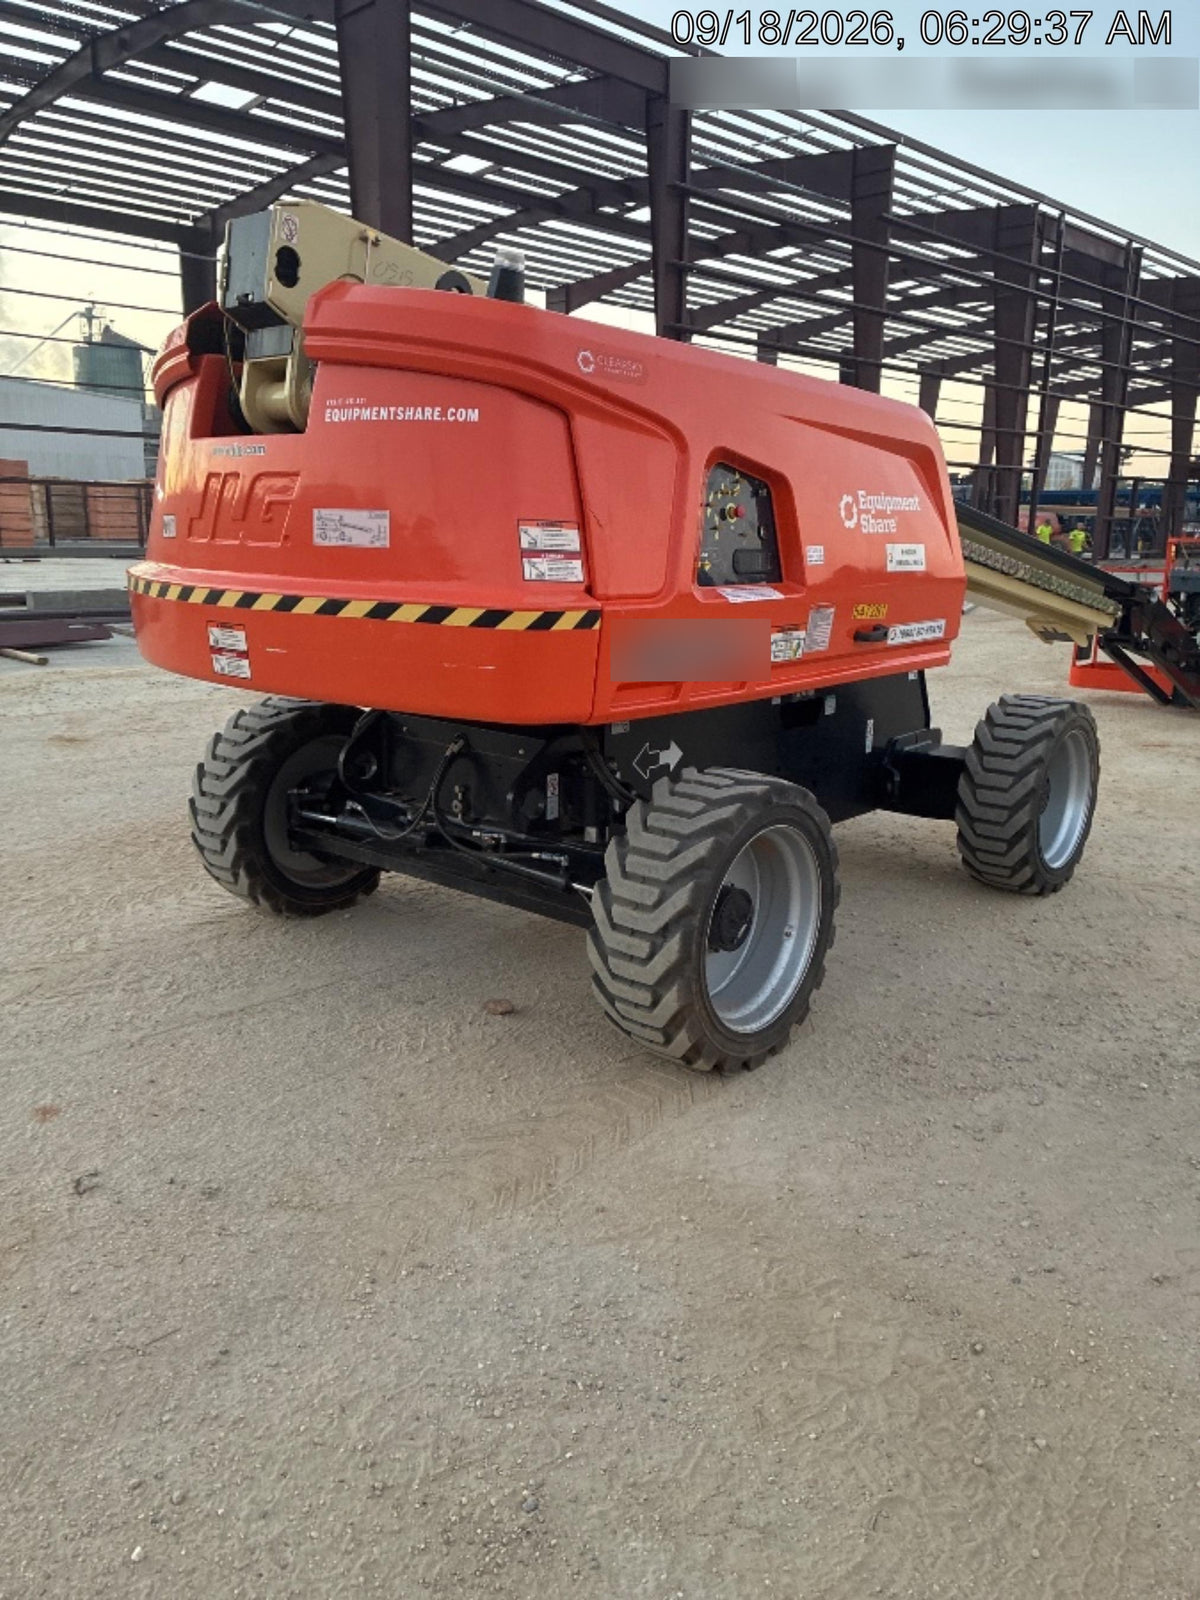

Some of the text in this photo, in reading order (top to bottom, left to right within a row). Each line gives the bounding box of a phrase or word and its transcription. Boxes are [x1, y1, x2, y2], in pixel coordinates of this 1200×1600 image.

[324, 406, 480, 422] EQUIPMENTSHARE.COM
[187, 470, 301, 548] JLG
[857, 490, 921, 514] Equipment
[860, 513, 897, 534] Share
